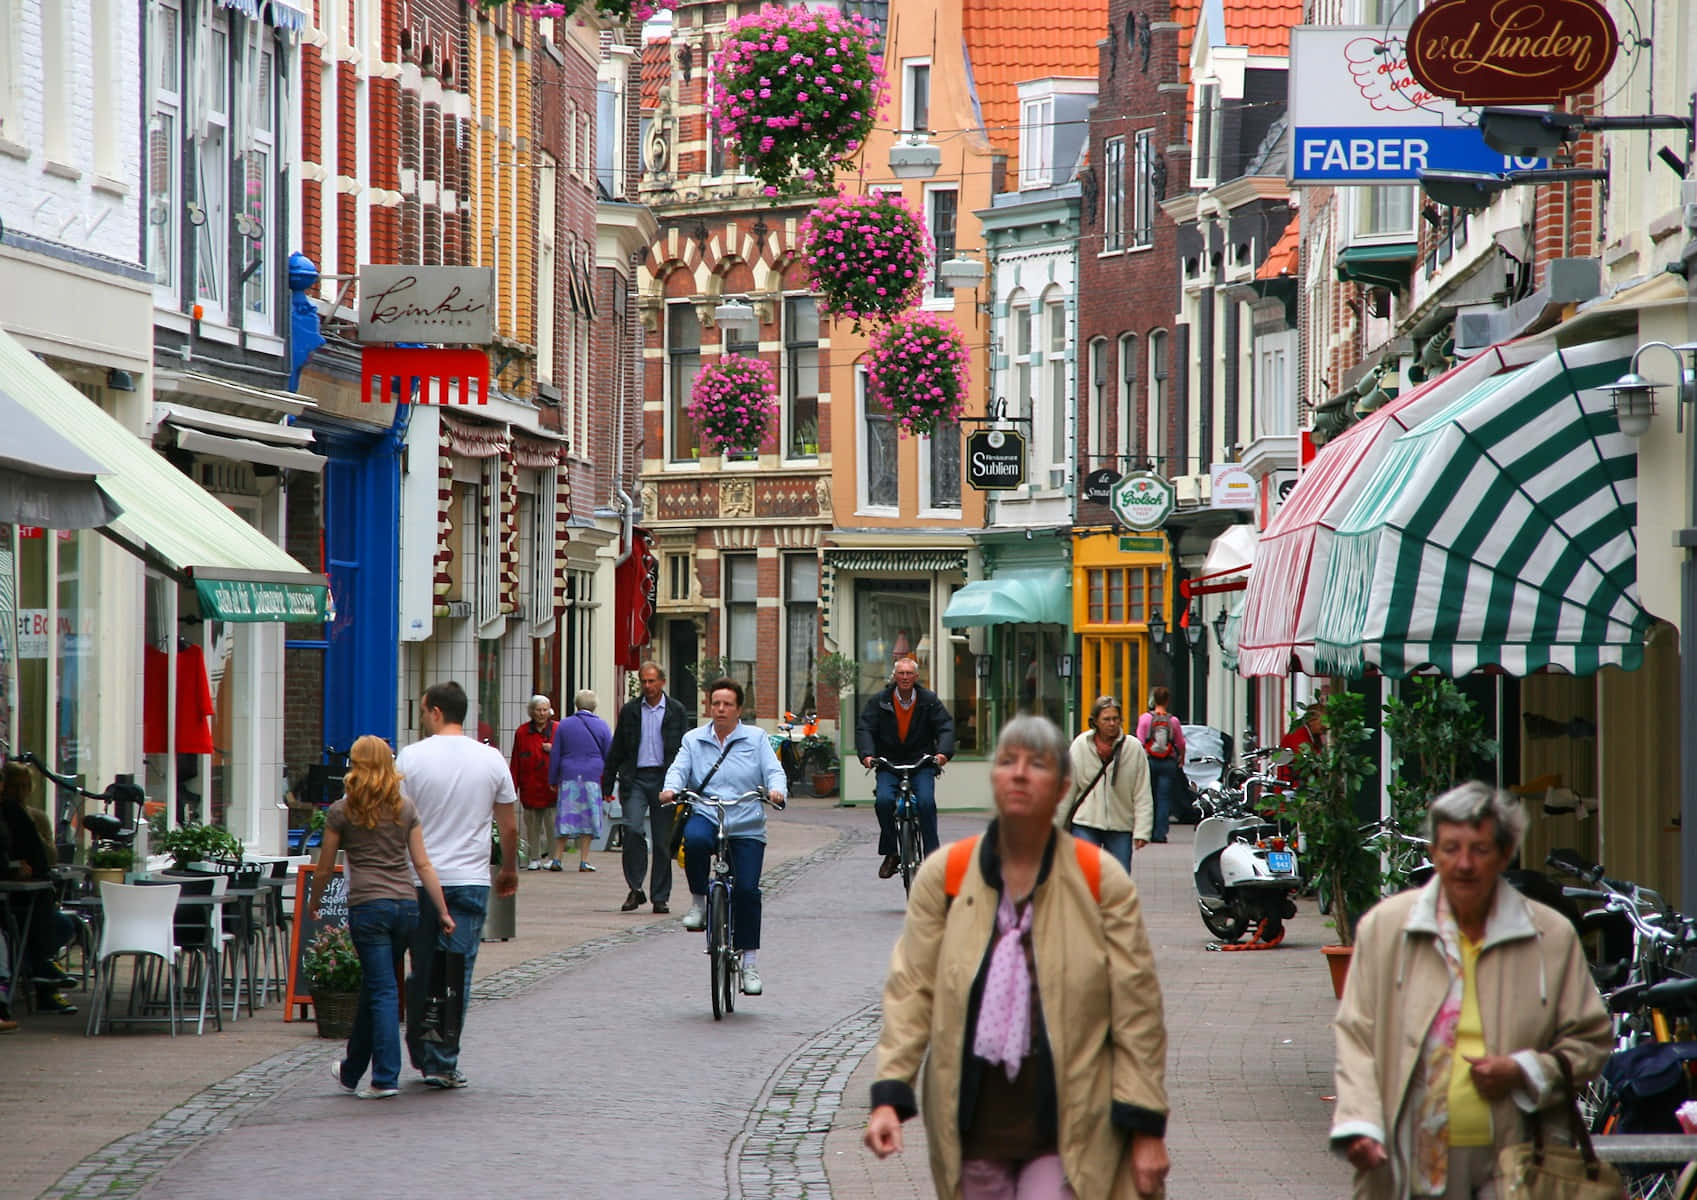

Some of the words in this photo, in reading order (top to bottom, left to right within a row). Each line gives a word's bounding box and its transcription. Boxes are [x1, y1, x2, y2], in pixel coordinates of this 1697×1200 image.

[1454, 1, 1593, 77] Linden
[1303, 139, 1429, 171] FABER
[973, 451, 1019, 477] Subliem
[1121, 490, 1164, 508] Grolsch
